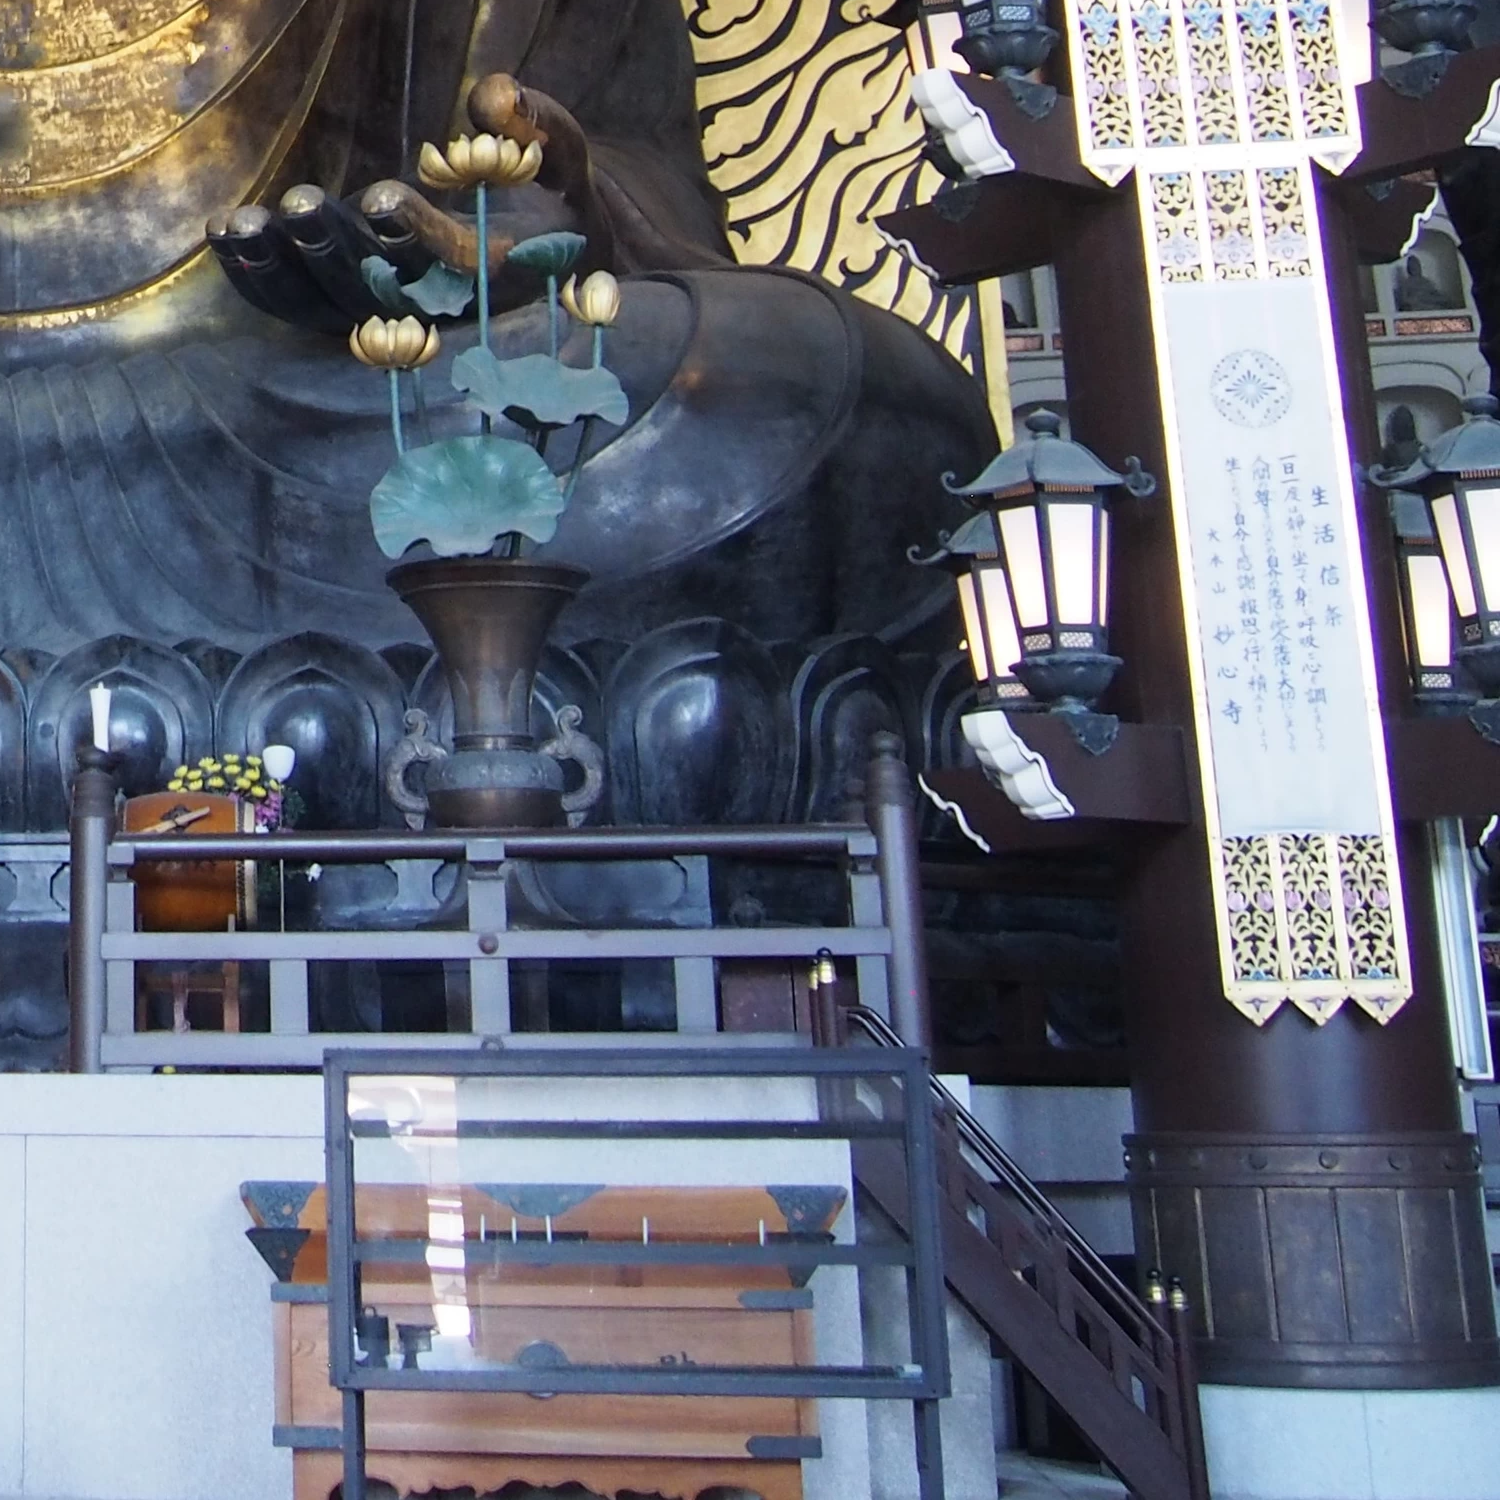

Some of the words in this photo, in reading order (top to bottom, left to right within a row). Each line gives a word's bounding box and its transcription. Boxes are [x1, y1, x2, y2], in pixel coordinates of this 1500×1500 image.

[1311, 485, 1342, 627] 生活信条
[1213, 624, 1243, 725] 妙心寺
